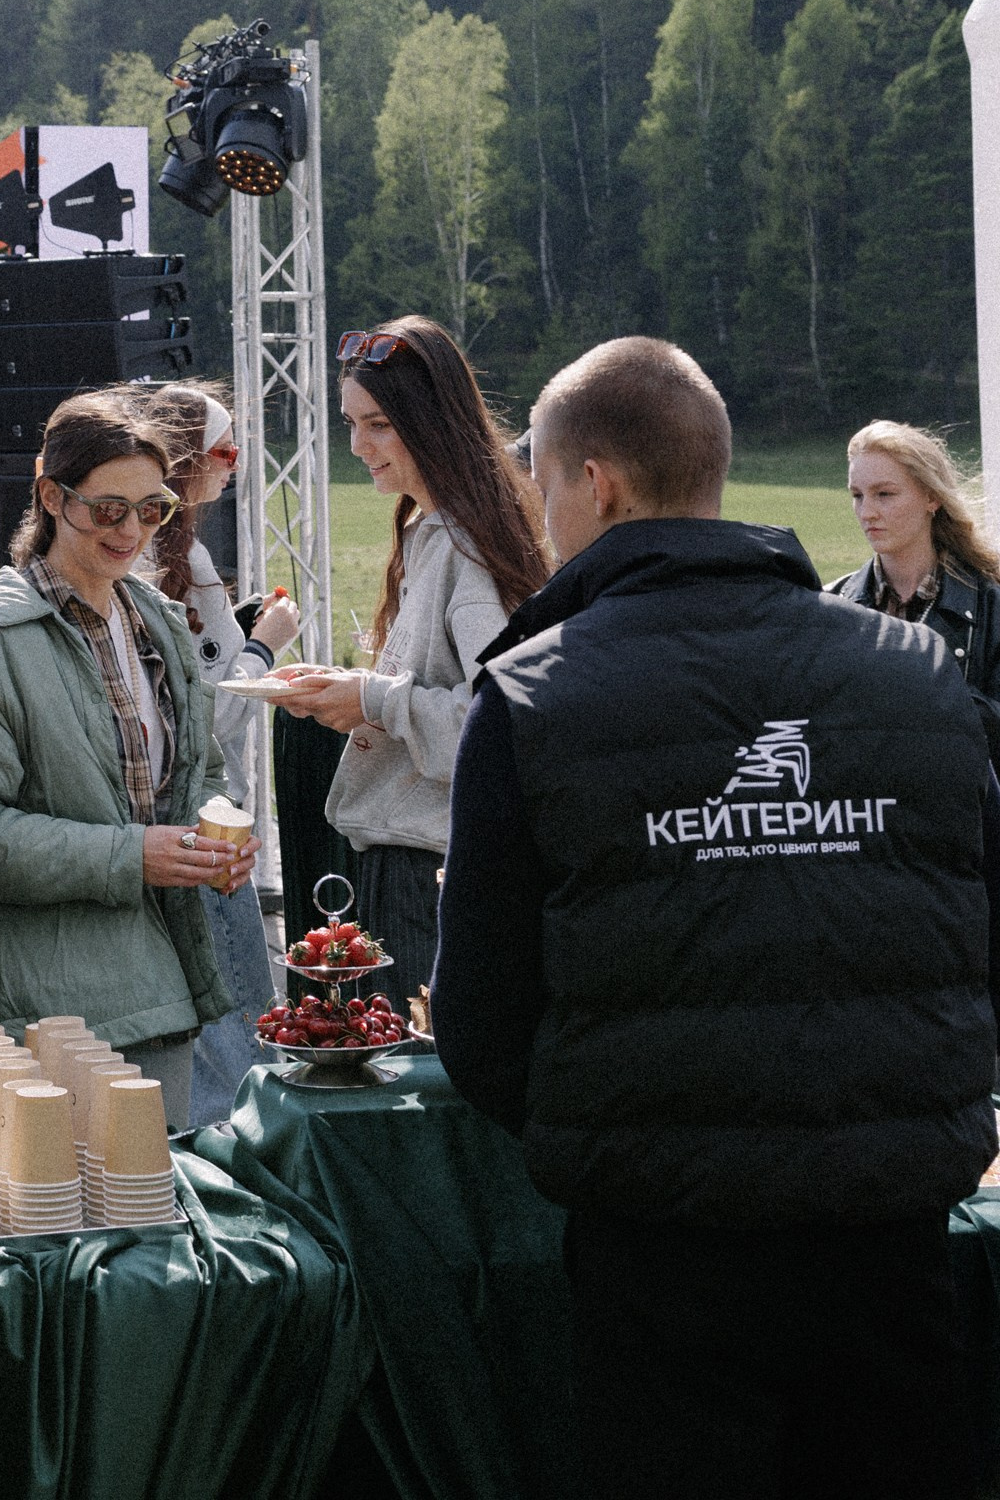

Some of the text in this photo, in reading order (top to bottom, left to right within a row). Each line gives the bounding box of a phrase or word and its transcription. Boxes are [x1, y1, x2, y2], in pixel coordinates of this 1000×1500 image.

[645, 796, 897, 846] КЕЙТЕРИНГ
[696, 840, 860, 861] ДЛЯ ТЕХ, КТО ЦЕНИТ ВРЕМЯ
